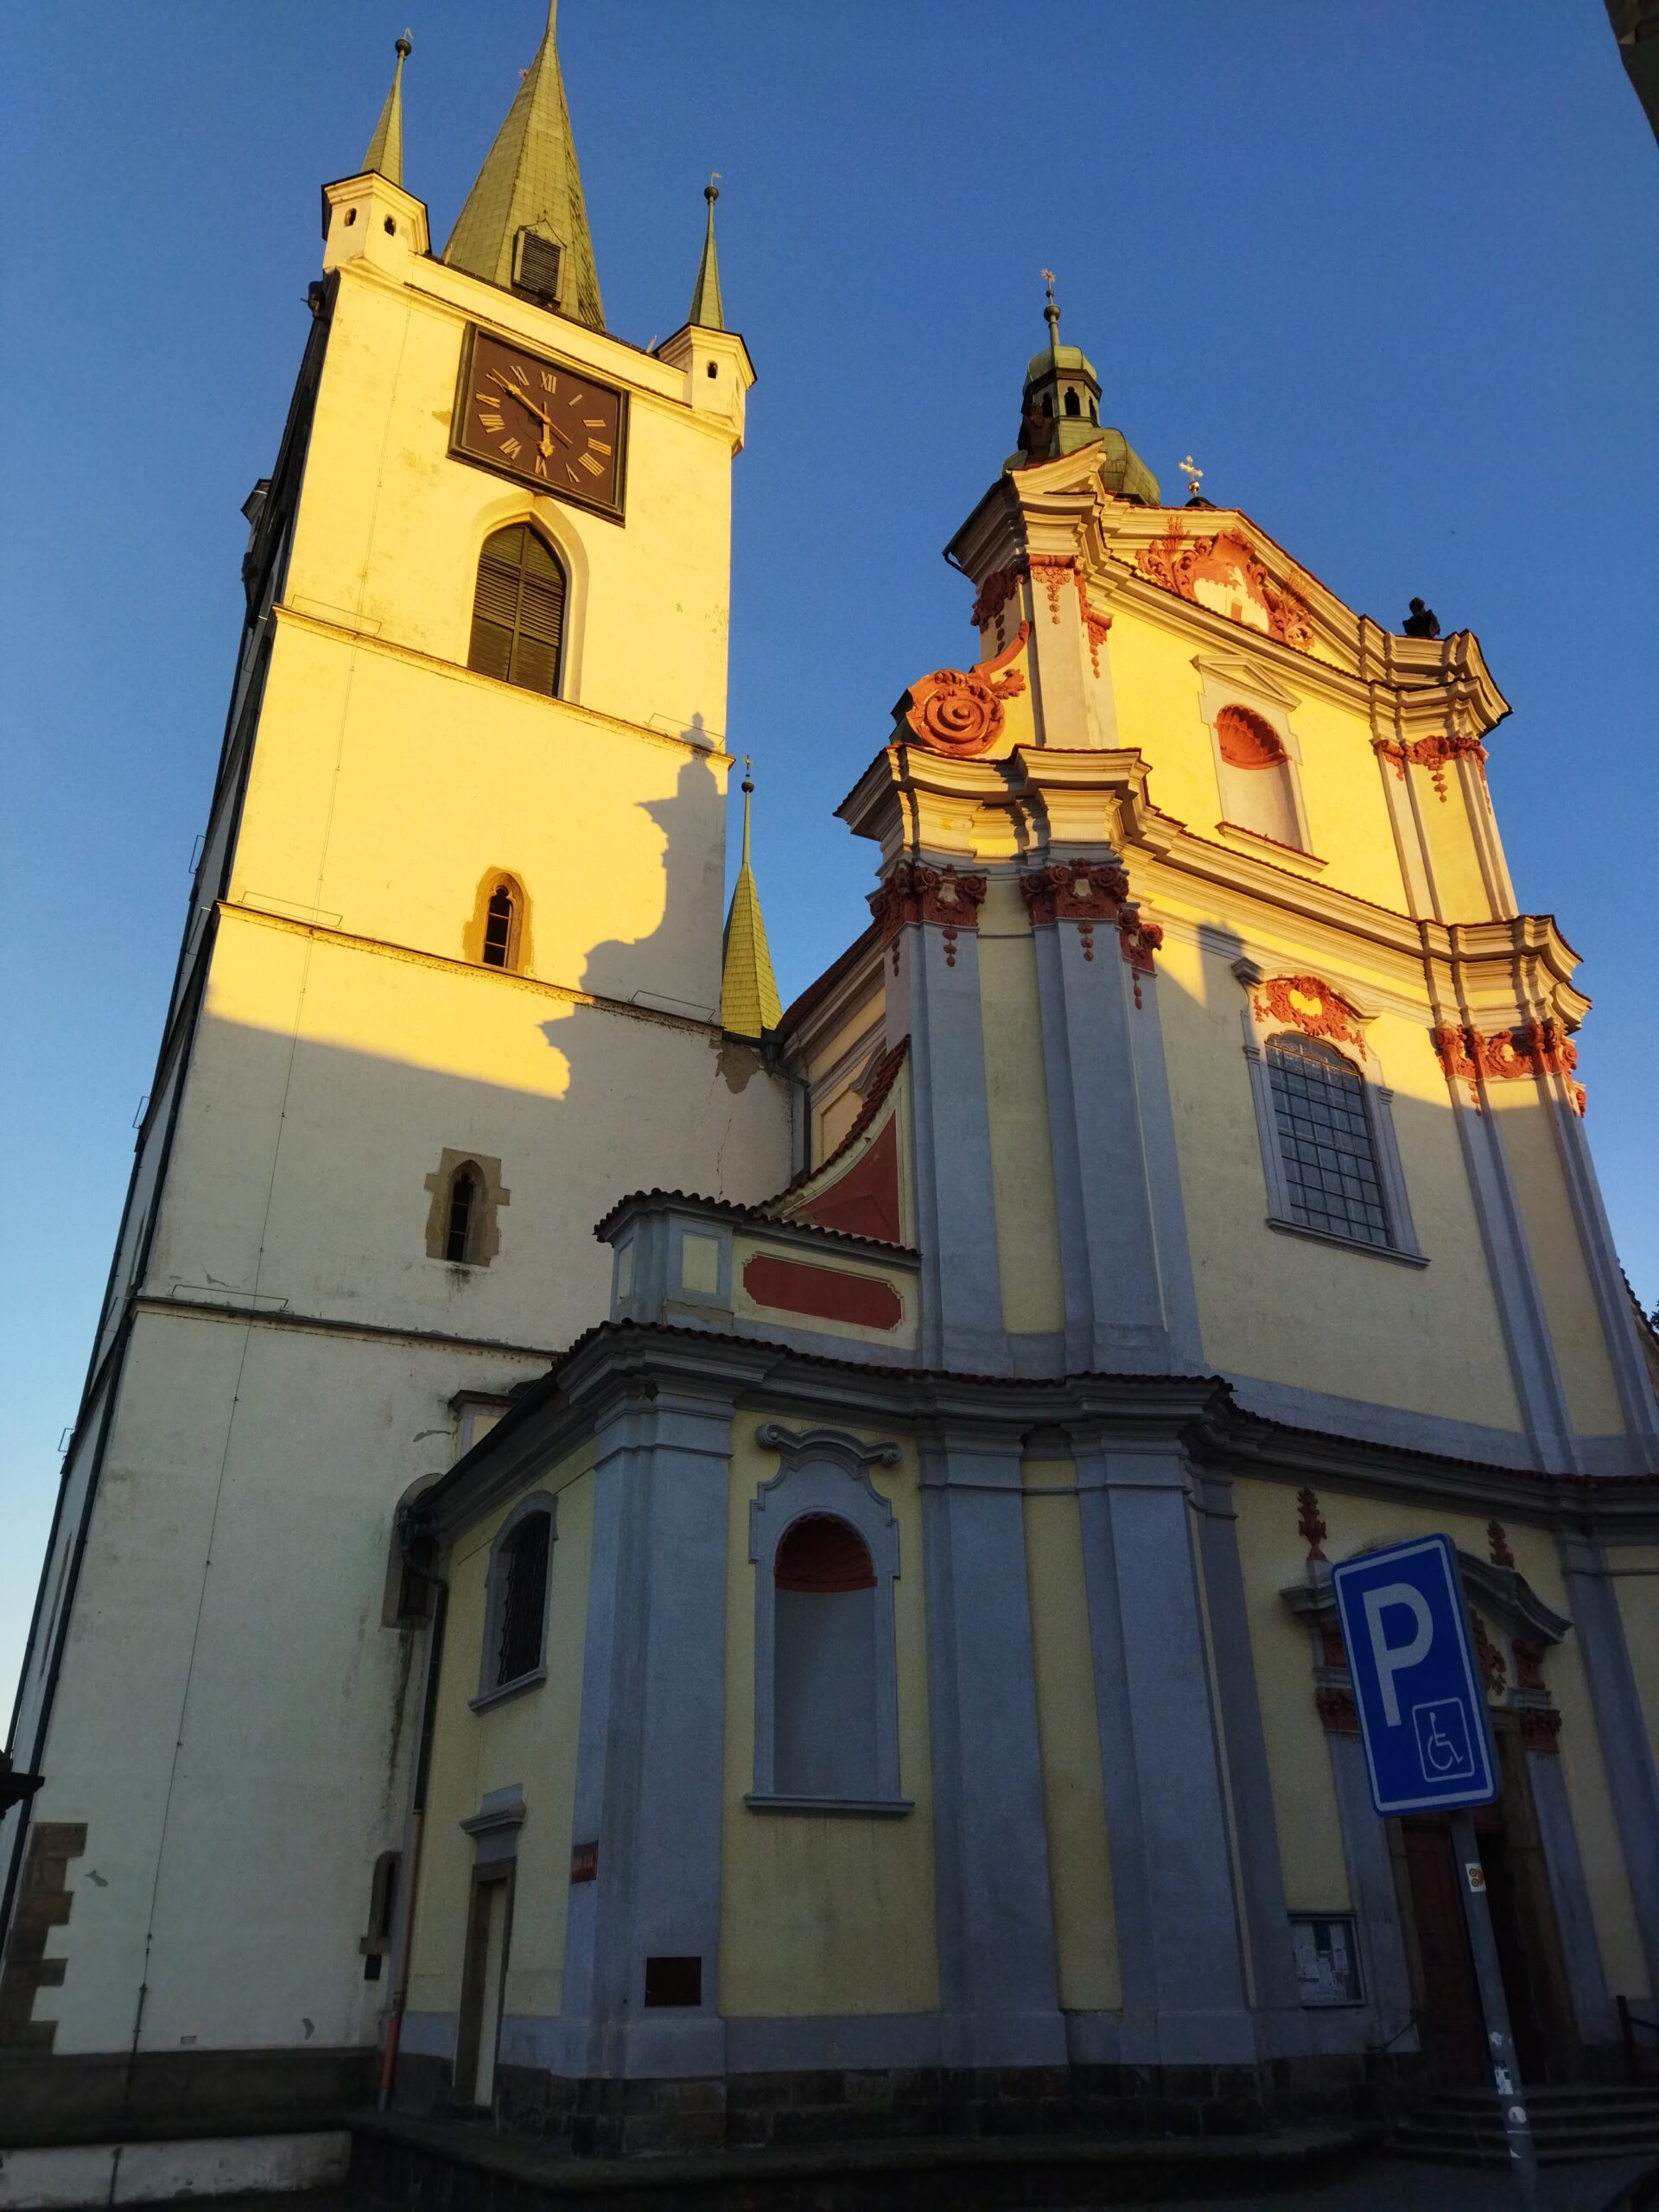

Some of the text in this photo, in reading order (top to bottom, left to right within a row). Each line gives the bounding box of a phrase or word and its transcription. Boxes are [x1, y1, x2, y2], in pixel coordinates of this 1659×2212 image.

[540, 370, 556, 394] XII
[569, 394, 583, 407] I
[583, 419, 606, 428] II
[588, 437, 611, 456] III
[566, 463, 580, 483] V
[1363, 1583, 1433, 1727] P
